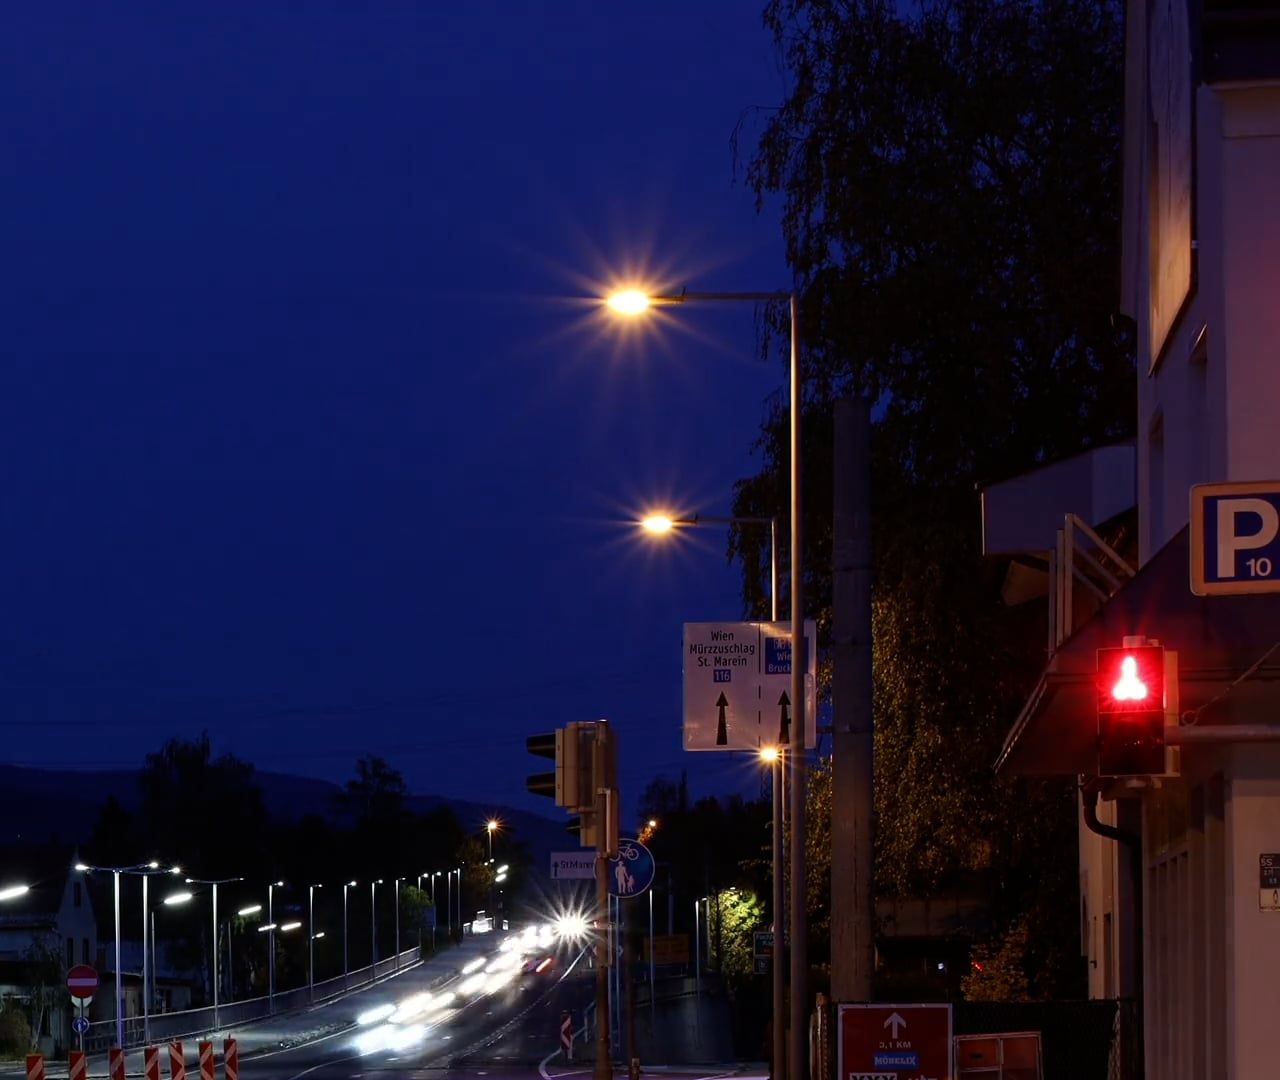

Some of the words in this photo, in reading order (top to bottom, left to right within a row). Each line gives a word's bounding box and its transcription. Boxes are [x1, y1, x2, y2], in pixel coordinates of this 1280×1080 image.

[1217, 498, 1279, 578] P
[1246, 558, 1272, 577] 10
[711, 631, 734, 641] Wien
[689, 643, 755, 655] Mürzzuschlag
[697, 657, 711, 667] St.
[714, 656, 747, 667] Marein
[777, 652, 792, 661] Wie
[715, 671, 730, 682] 116
[896, 1041, 911, 1049] KM
